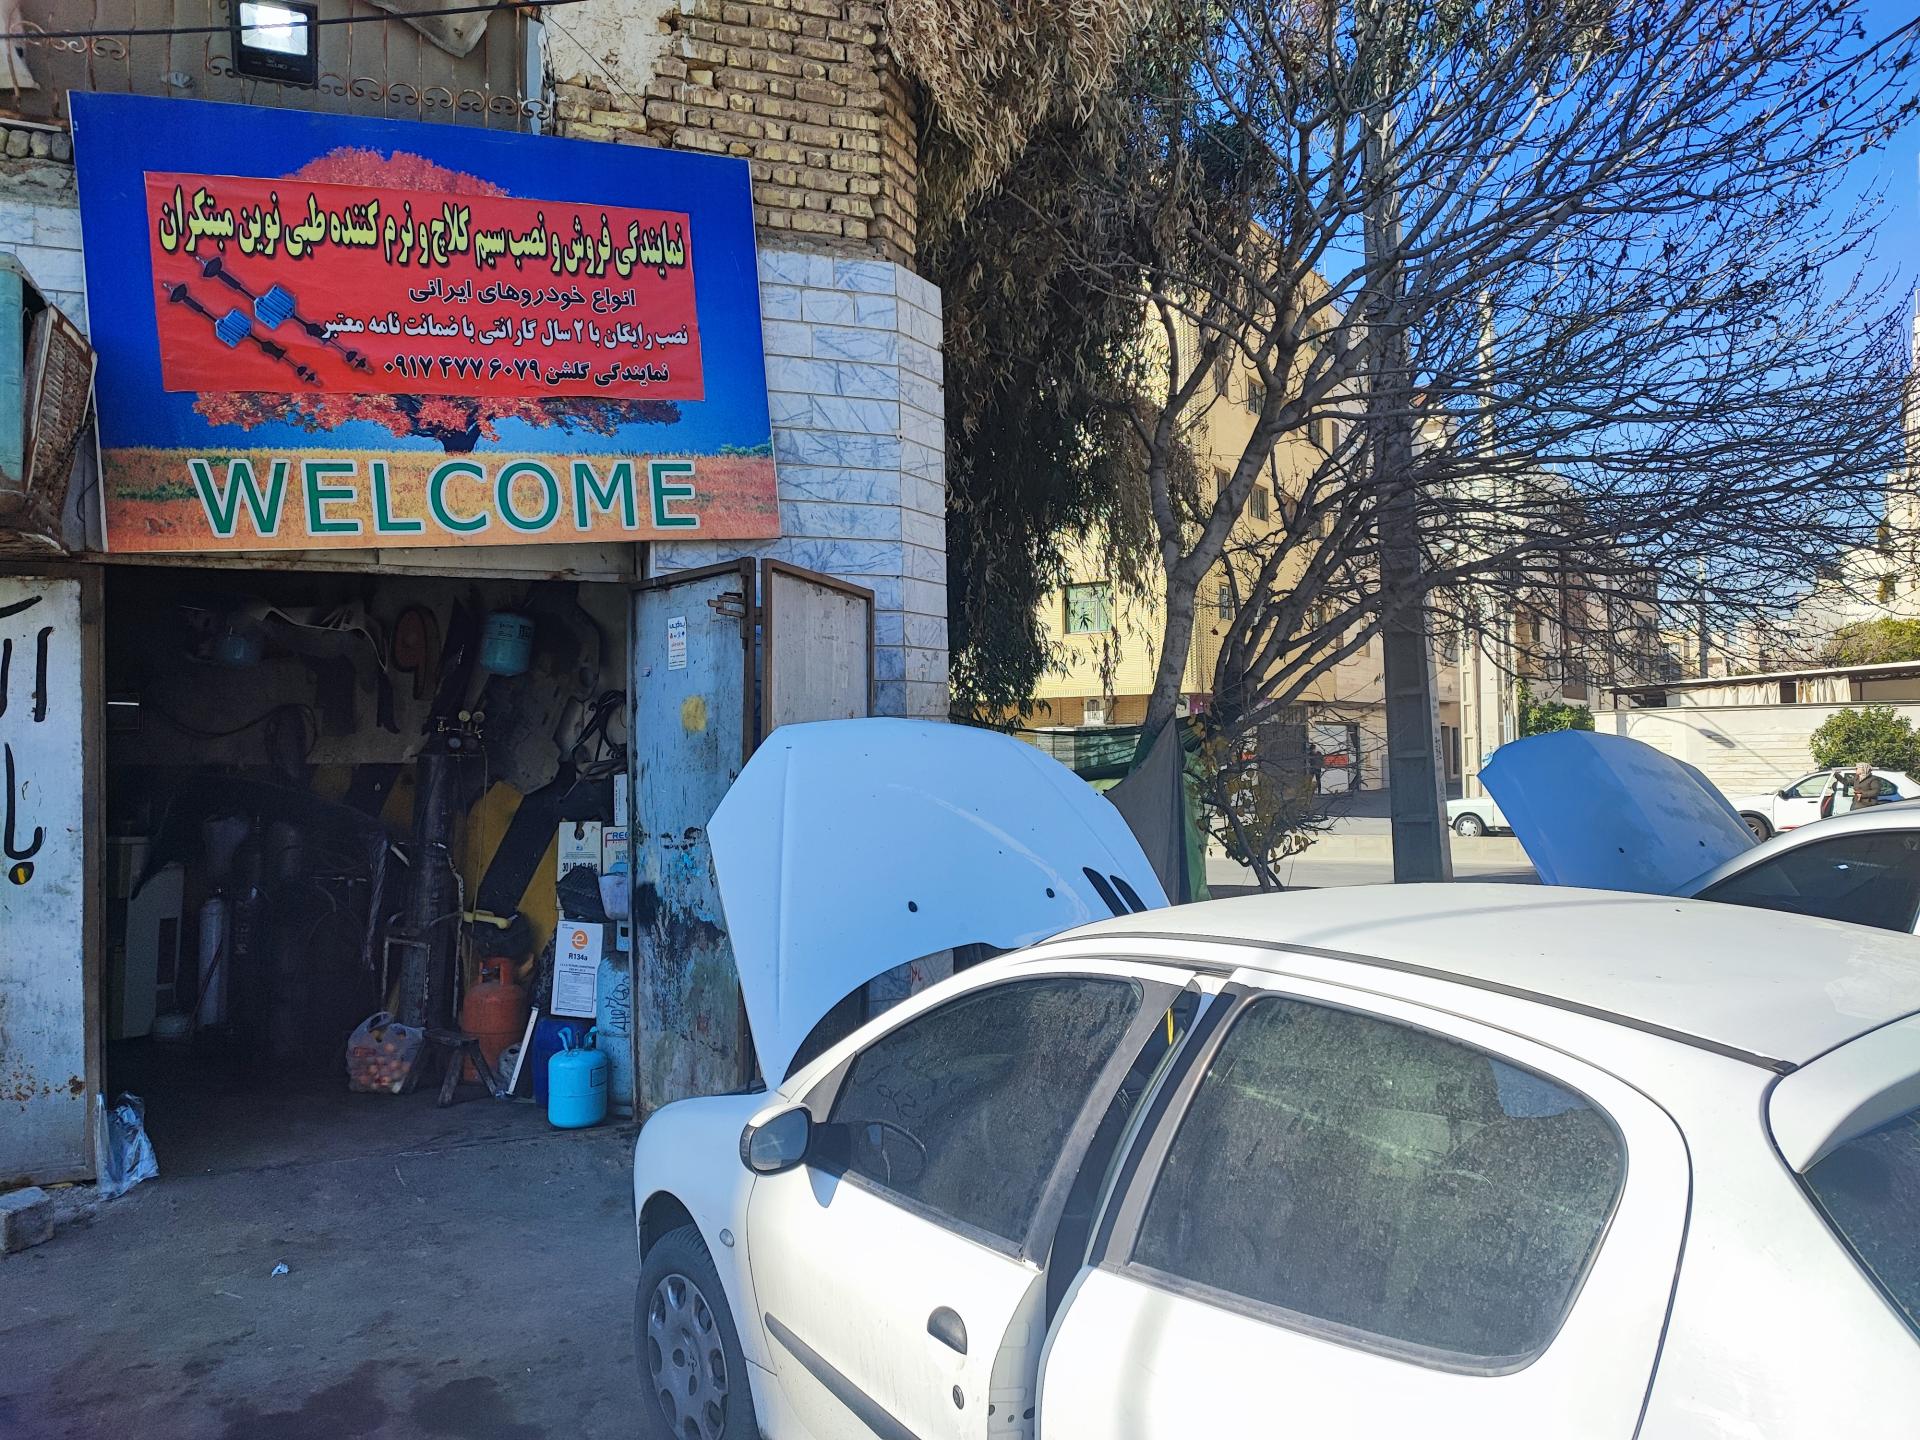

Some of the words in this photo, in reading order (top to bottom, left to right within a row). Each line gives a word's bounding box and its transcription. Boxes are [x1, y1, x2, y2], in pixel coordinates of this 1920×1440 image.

[160, 184, 234, 252] مبتکران
[239, 191, 281, 256] نوین
[285, 192, 326, 257] طبی
[330, 198, 379, 246] کننده
[385, 200, 415, 264] نرم
[418, 222, 429, 264] و
[430, 202, 470, 264] کلاچ
[475, 228, 505, 267] سیم
[508, 211, 547, 269] نصب
[563, 213, 612, 276] فروش
[551, 232, 562, 273] و
[615, 220, 686, 278] نمایندگی
[408, 278, 472, 303] ایرانی
[478, 280, 587, 311] خودروهای
[591, 289, 636, 313] انواع
[321, 313, 365, 339] معتبر
[368, 312, 400, 335] نامه
[403, 314, 459, 337] ضمانت
[461, 315, 475, 343] با
[478, 317, 537, 346] گارانتی
[541, 319, 571, 346] سال
[573, 319, 584, 344] ۲
[587, 319, 600, 347] با
[603, 321, 653, 350] رایگان
[654, 324, 689, 349] نصب
[545, 360, 591, 385] گلشن
[594, 361, 669, 386] نمایندگی
[188, 458, 700, 538] WELCOME
[568, 952, 588, 961] R134a
